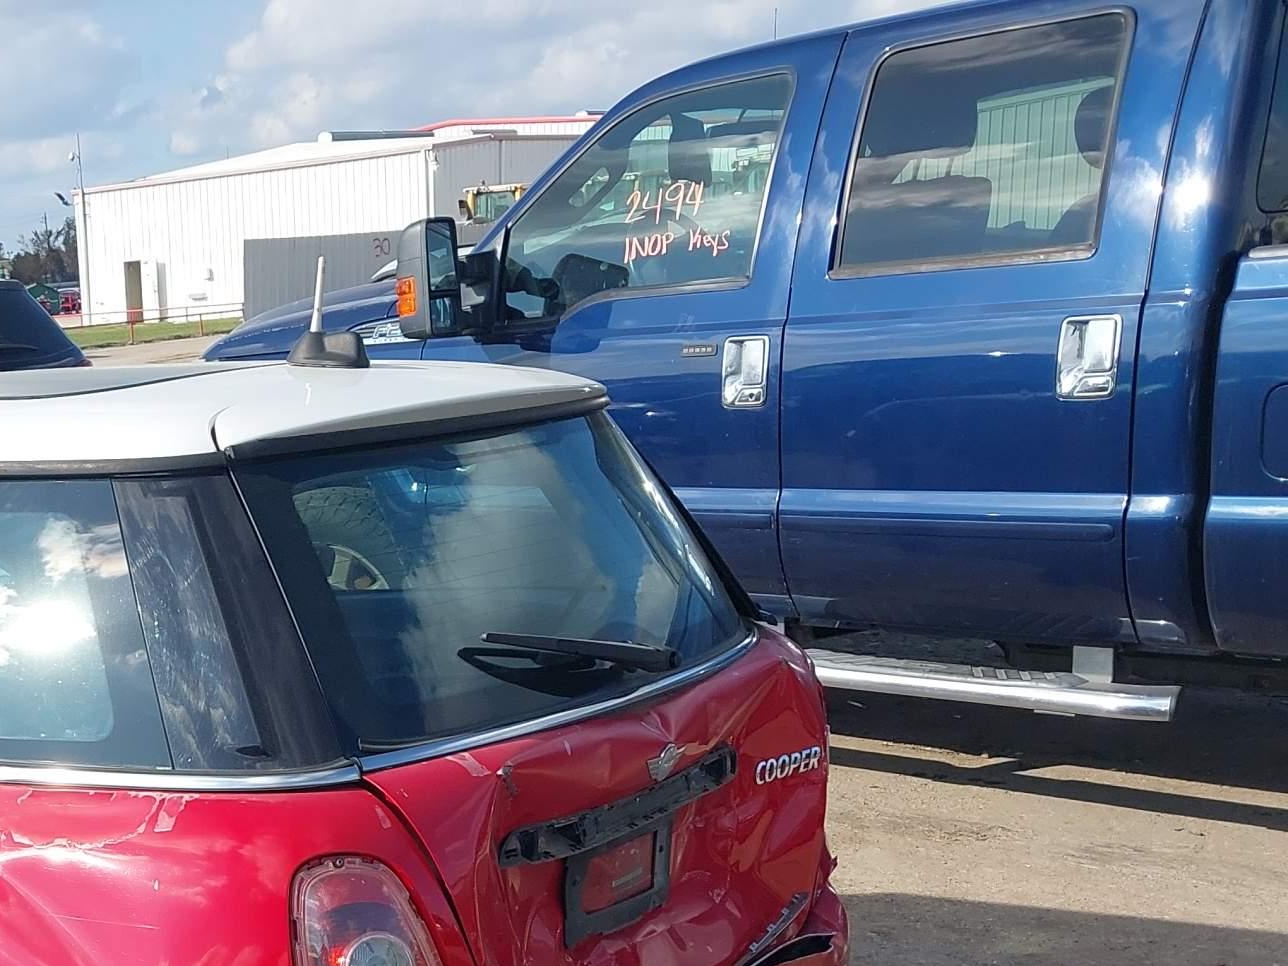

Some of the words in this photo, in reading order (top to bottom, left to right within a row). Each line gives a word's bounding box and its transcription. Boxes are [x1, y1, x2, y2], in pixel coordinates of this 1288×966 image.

[624, 181, 704, 224] 2494
[624, 232, 674, 264] INOP
[755, 746, 821, 785] COOPER
